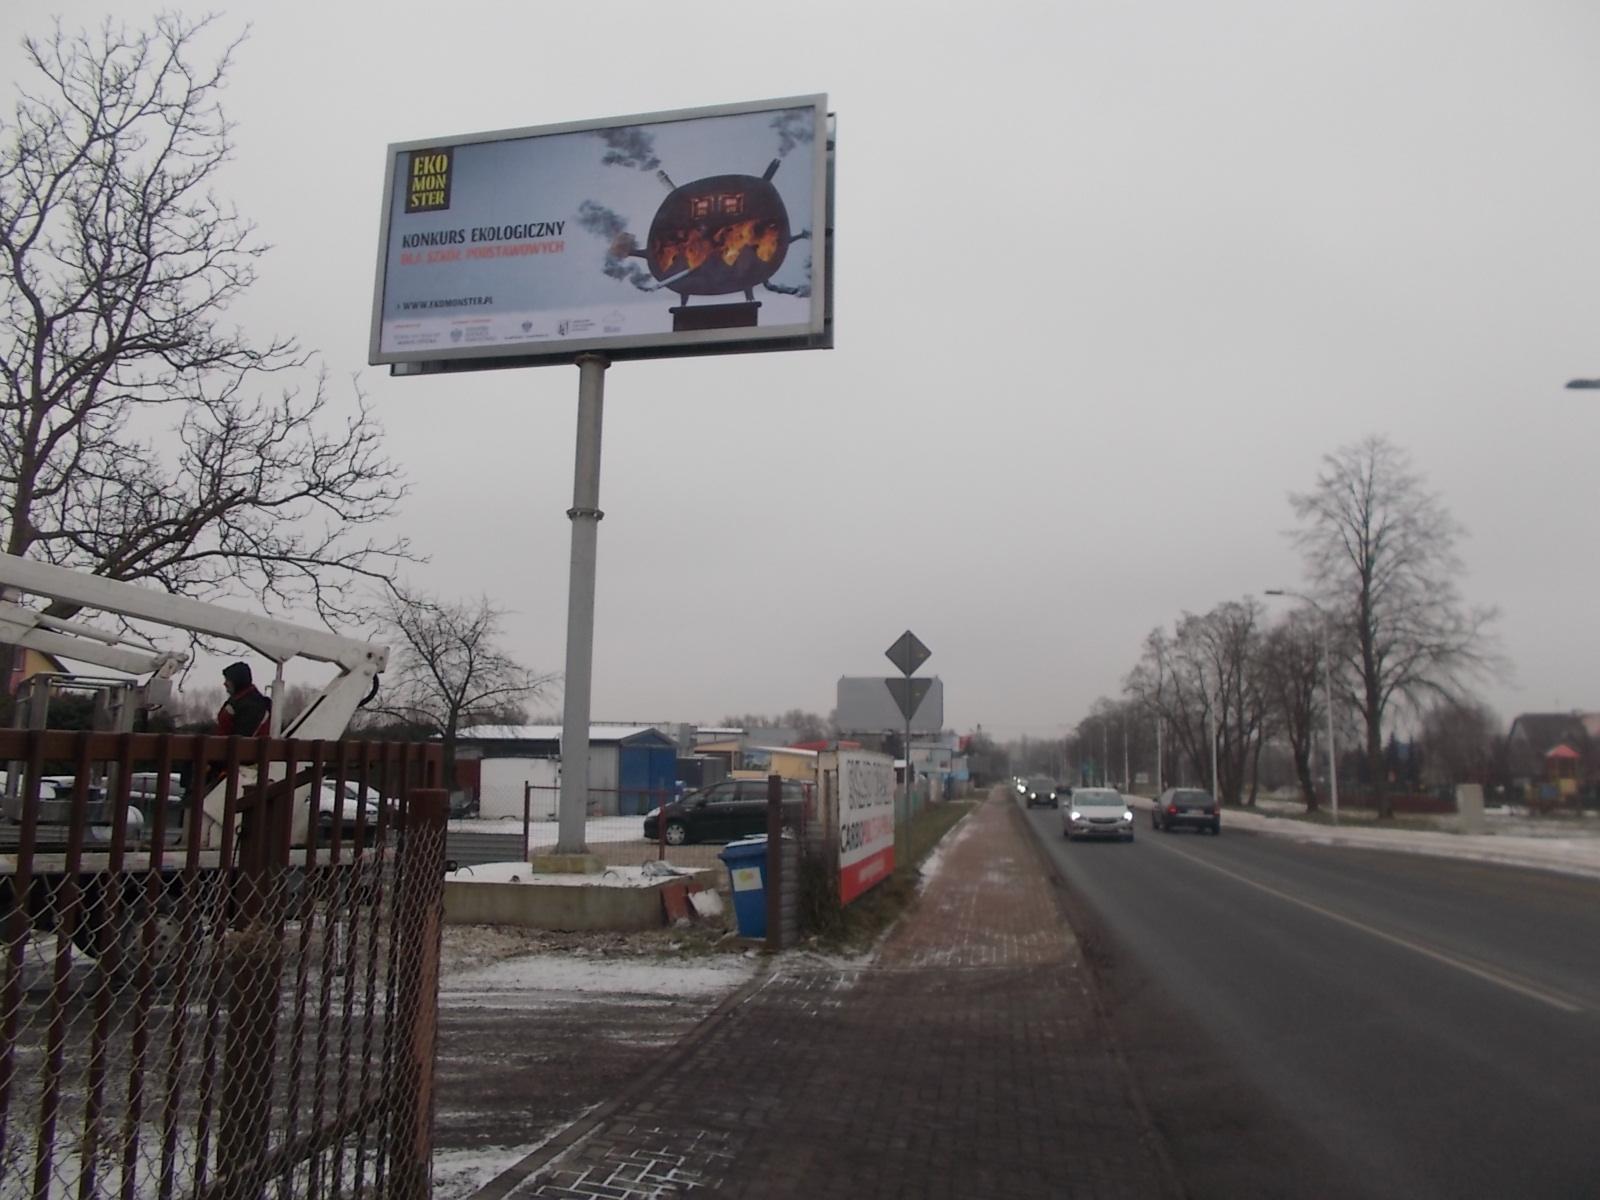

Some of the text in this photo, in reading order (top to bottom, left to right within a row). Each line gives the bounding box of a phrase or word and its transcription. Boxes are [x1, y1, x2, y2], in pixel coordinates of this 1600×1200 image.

[413, 154, 448, 175] EKO
[412, 174, 446, 192] MON
[411, 190, 445, 207] STER
[402, 220, 566, 249] KONKURS EKOLOGICZNY
